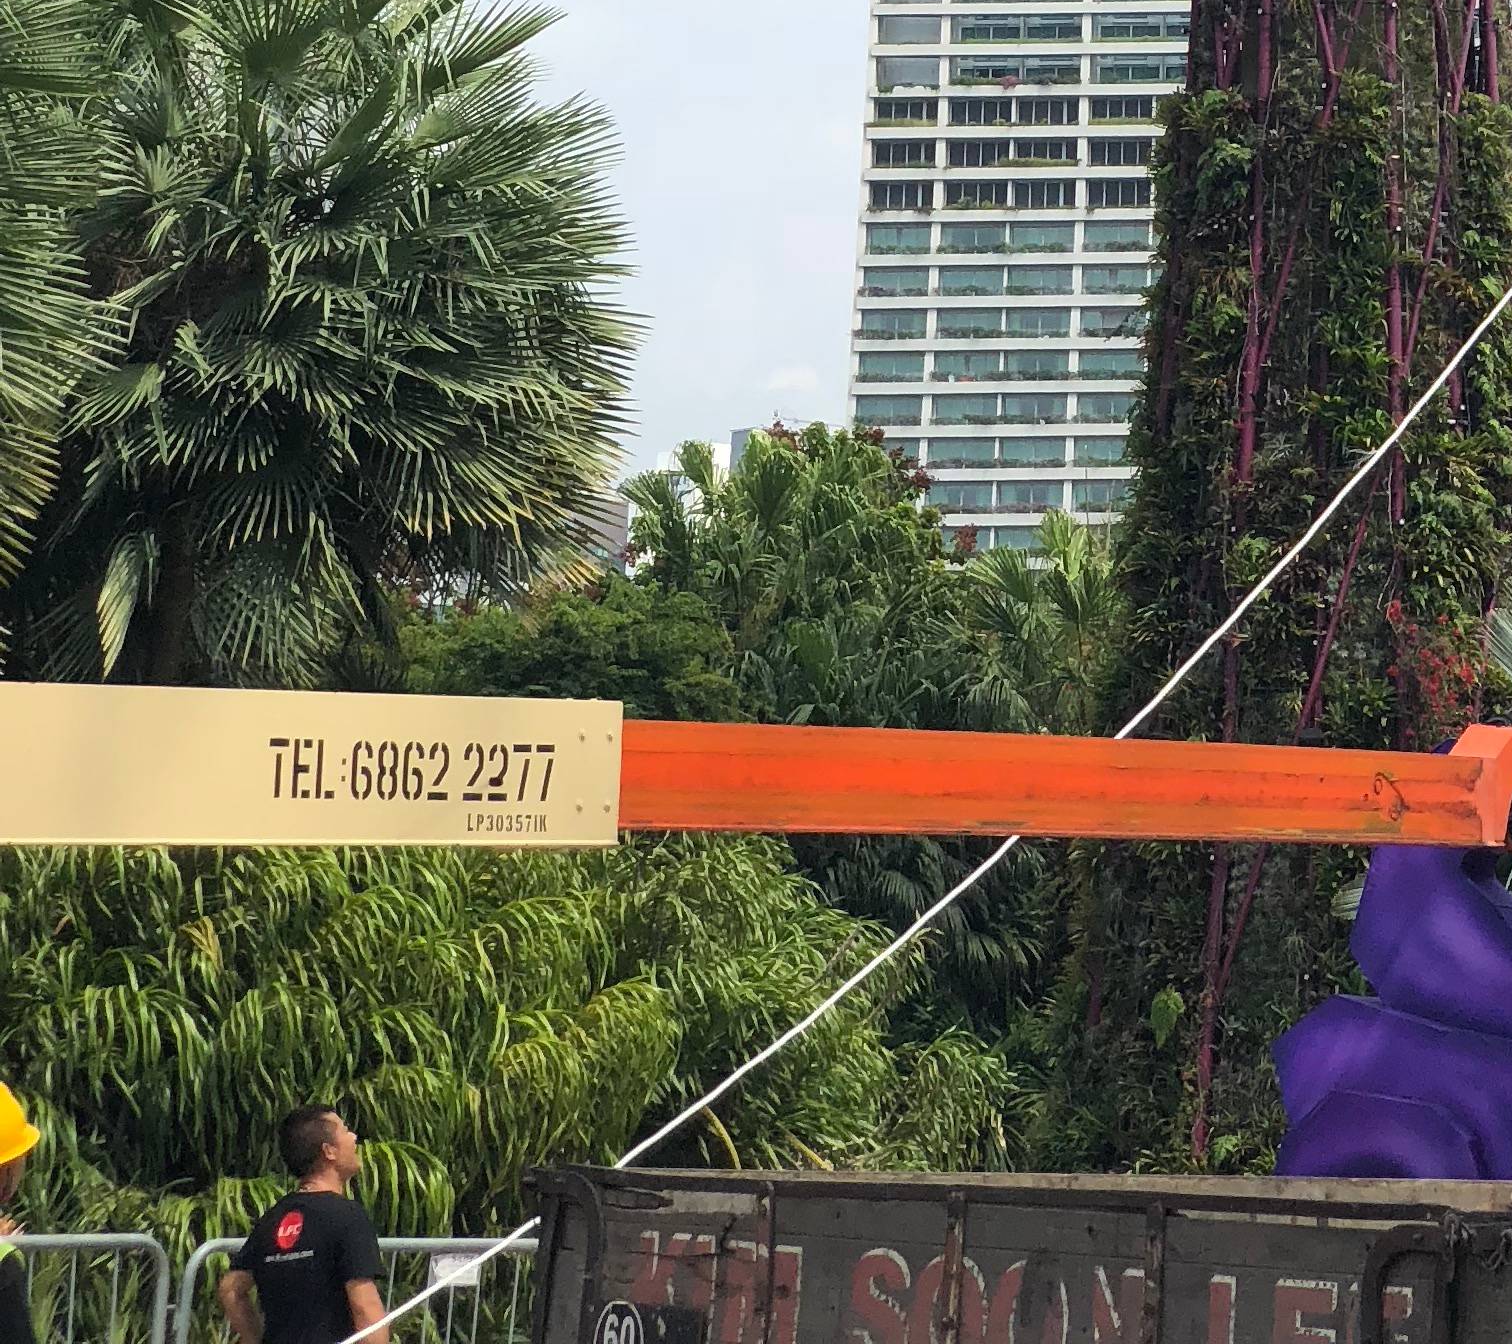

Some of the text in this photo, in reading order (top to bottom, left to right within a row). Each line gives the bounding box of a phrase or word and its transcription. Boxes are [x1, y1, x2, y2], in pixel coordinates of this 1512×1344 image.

[269, 737, 556, 802] TEL:6862 2277
[603, 1313, 636, 1344] 60
